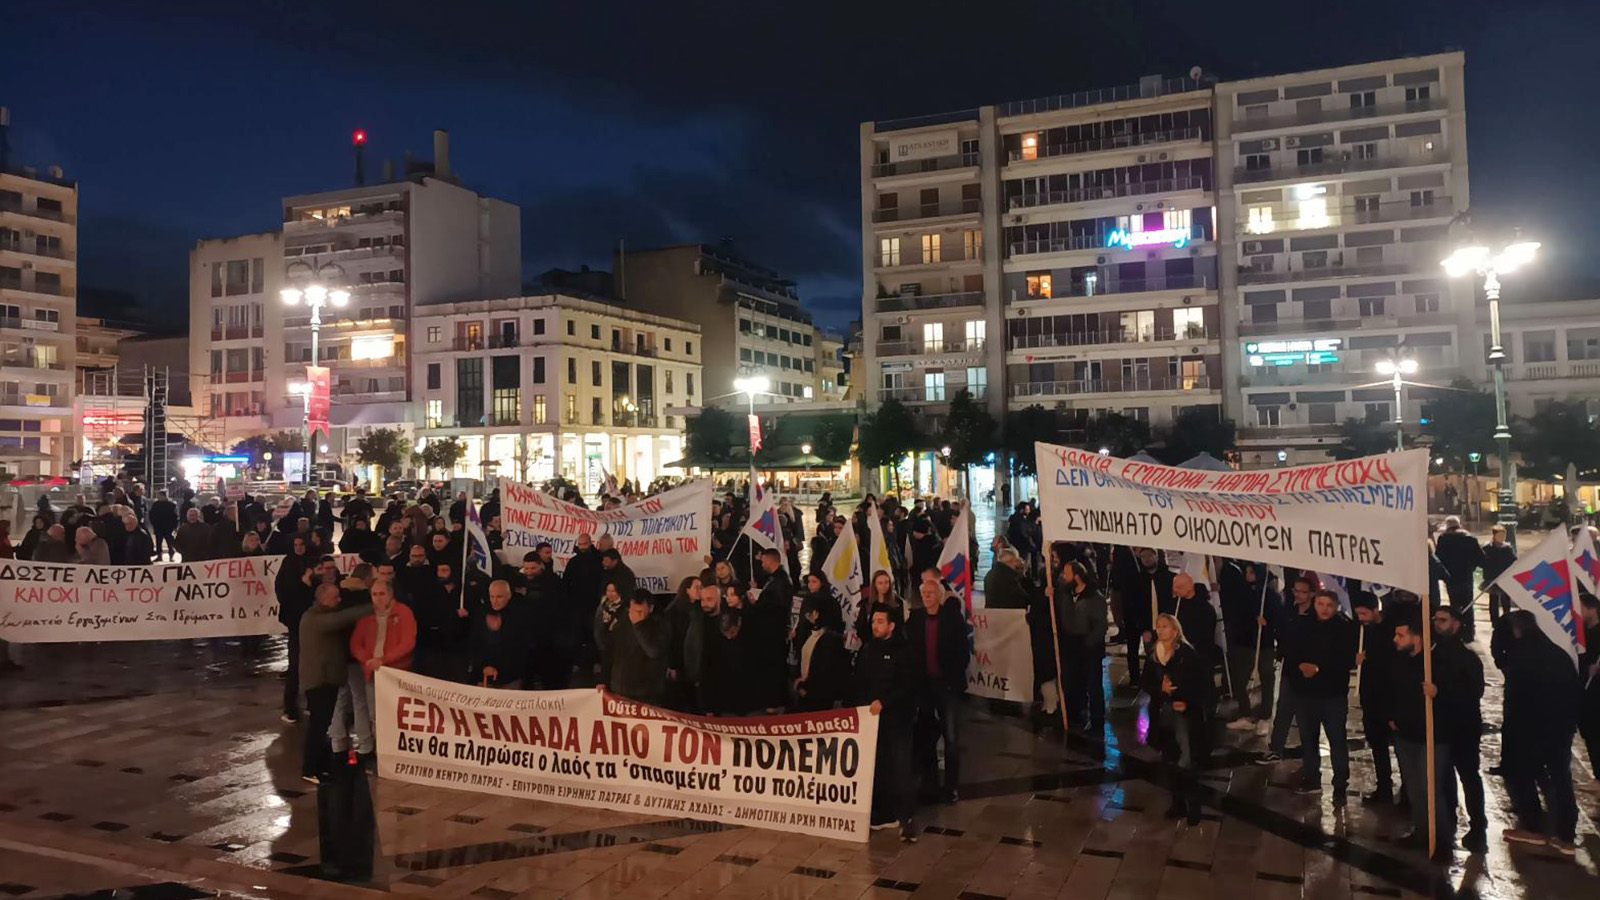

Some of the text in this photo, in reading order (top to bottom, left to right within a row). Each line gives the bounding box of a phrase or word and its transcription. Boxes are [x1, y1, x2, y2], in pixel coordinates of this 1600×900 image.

[1056, 469, 1089, 486] ΔΕΝ
[1319, 484, 1414, 511] ΣΠΑΣΜΕΝΑ
[1265, 458, 1397, 494] ΣΥΜΜΕΤΟΧΗ
[635, 497, 664, 516] ΤΟΥ
[1142, 490, 1174, 511] ΤΟΥ
[652, 538, 673, 555] ΑΠΟ
[675, 535, 698, 553] ΤΟΝ
[1066, 507, 1384, 566] ΣΥΝΔΙΚΑΤΟ ΟΙΚΟΔΟΜΩΝ ΠΑΤΡΑΣ
[0, 564, 77, 583] ΔΩΣΤΕ
[85, 566, 154, 585] ΛΕΦΤΑ
[203, 559, 256, 579] ΥΓΕΙΑ
[14, 580, 268, 604] ΚΑΙ ΟΧΙ ΓΙΑ ΤΟΥ ΝΑΤΟ ΤΑ
[607, 699, 638, 716] Ούτε
[770, 723, 803, 735] στον
[804, 715, 856, 733] Άραξο!
[397, 696, 860, 778] ΕΞΩ Η ΕΛΛΑΔΑ ΑΠΟ ΤΟΝ ΠΟΛΕΜΟ
[397, 731, 424, 753] Δεν
[428, 735, 449, 759] θα
[454, 739, 535, 769] πληρώσει
[538, 756, 547, 772] ο
[551, 752, 591, 779] λαός
[594, 761, 618, 780] τα
[732, 773, 766, 795] του
[772, 778, 858, 805] πολέμου!
[394, 762, 434, 779] ΕΡΓΑΤΙΚΟ
[435, 768, 469, 784] ΚΕΝΤΡΟ
[471, 773, 504, 789] ΠΑΤΡΑΣ
[512, 779, 556, 796] ΕΠΙΤΡΟΠΗ
[557, 784, 598, 801] ΕΙΡΗΝΗΣ
[598, 789, 633, 805] ΠΑΤΡΑΣ
[644, 794, 686, 811] ΔΥΤΙΚΗΣ
[688, 799, 725, 817] ΑΧΑΪΑΣ
[734, 806, 787, 824] ΔΗΜΟΤΙΚΗ
[789, 810, 816, 827] ΑΡΧΗ
[818, 815, 856, 833] ΠΑΤΡΑΣ
